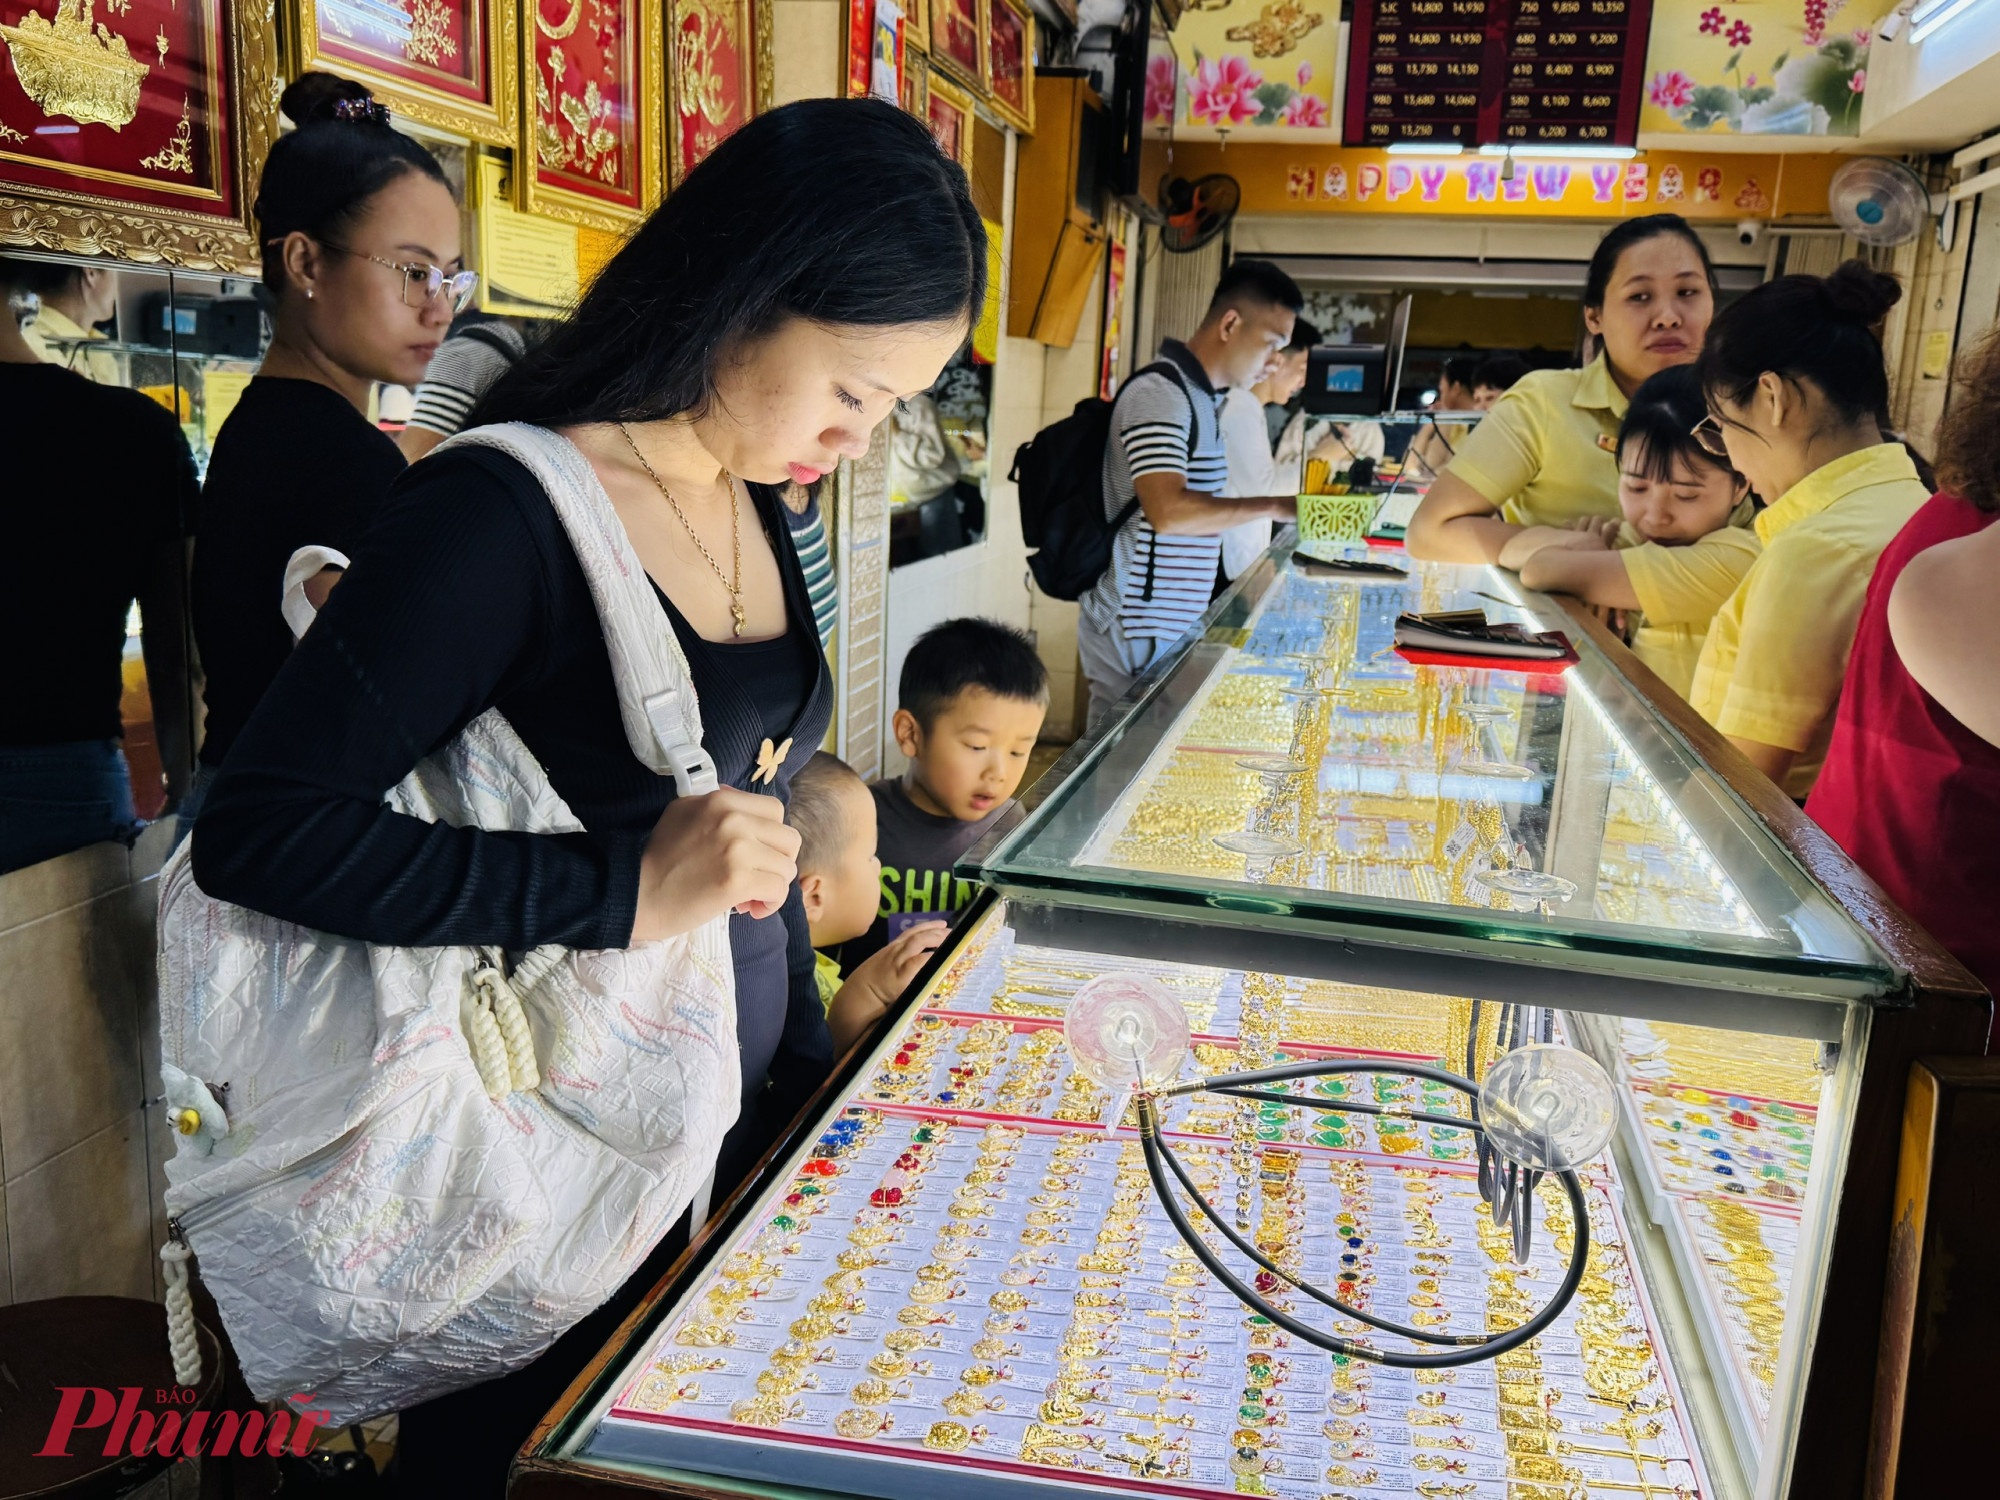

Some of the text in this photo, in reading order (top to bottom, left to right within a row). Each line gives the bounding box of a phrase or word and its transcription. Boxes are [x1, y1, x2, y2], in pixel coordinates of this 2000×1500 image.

[1380, 2, 1399, 13] SJC
[1520, 2, 1539, 13] 750
[1377, 33, 1397, 44] 999
[1548, 33, 1577, 45] 8,700
[1590, 33, 1618, 46] 9,200
[1513, 63, 1533, 75] 610
[1586, 63, 1615, 76] 8,900
[1542, 95, 1570, 107] 8,100
[1452, 124, 1461, 136] 0
[1507, 125, 1608, 139] 410 6,200 6,700
[1287, 162, 1722, 203] HAPPY NEW YEAR
